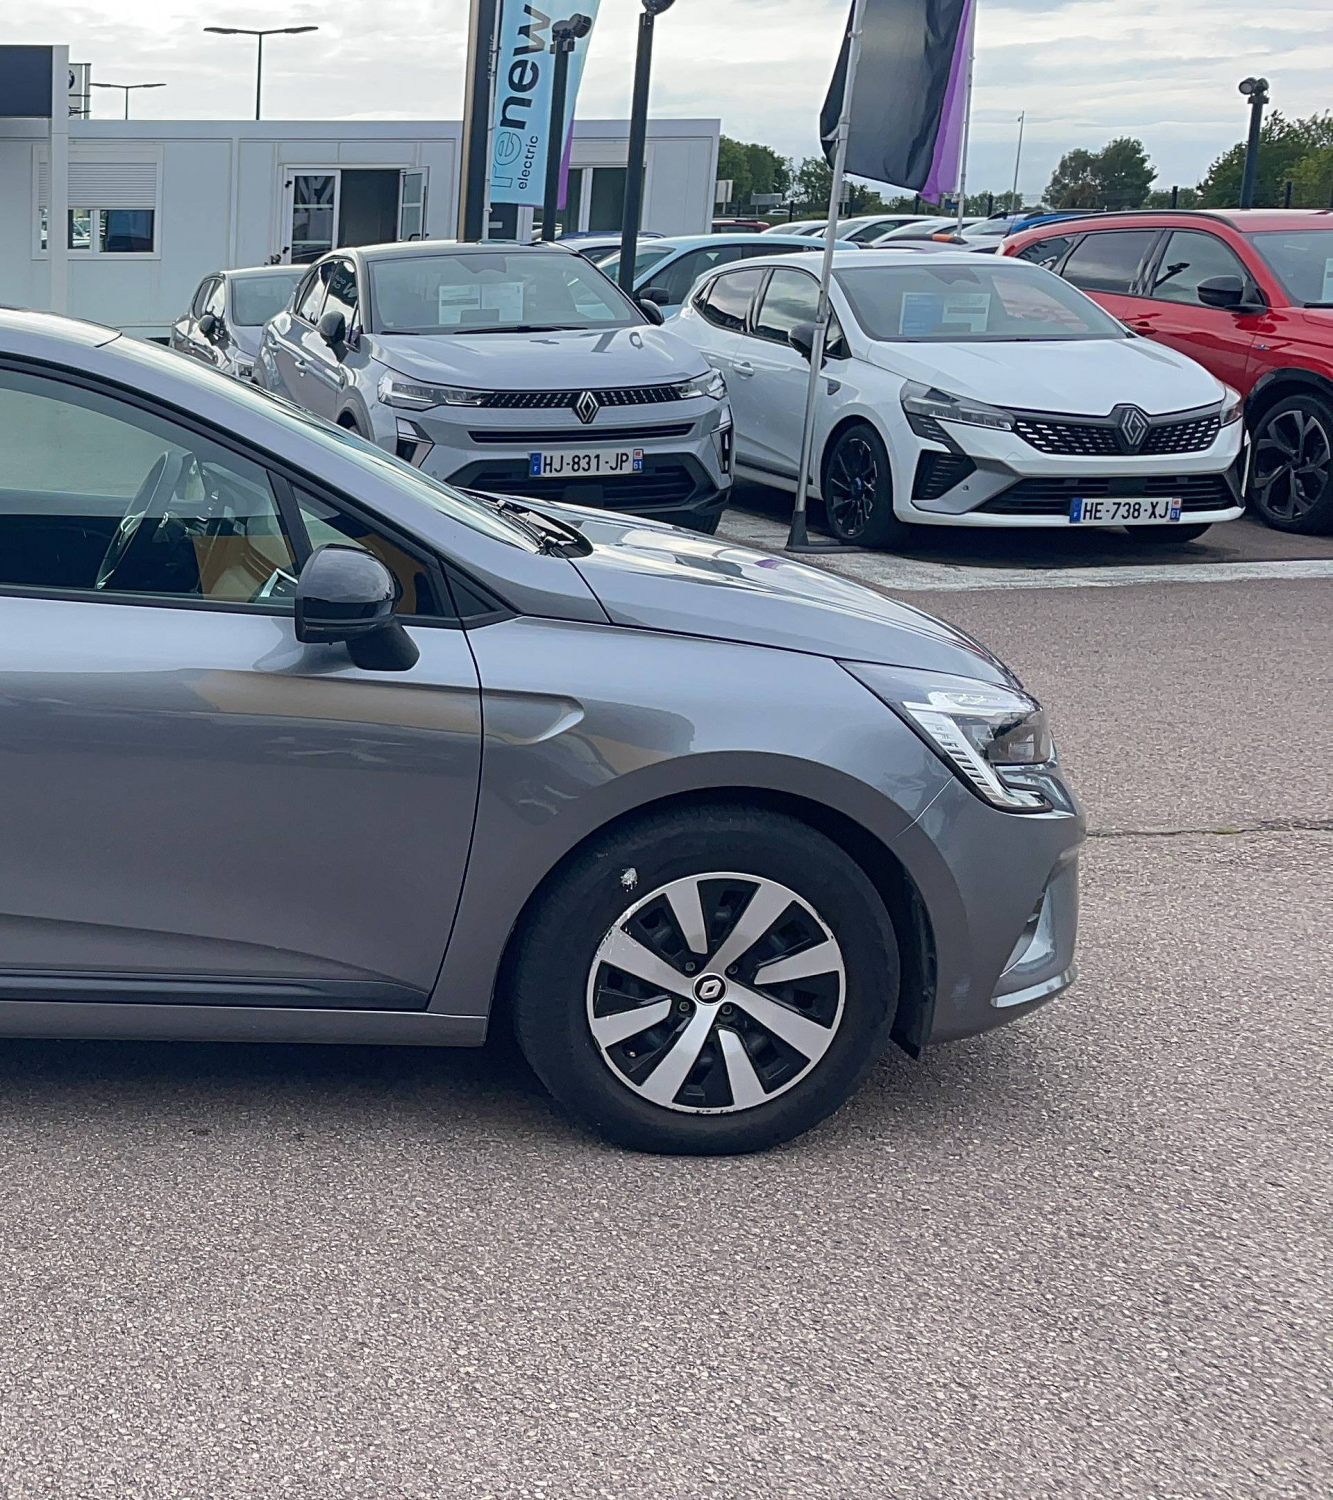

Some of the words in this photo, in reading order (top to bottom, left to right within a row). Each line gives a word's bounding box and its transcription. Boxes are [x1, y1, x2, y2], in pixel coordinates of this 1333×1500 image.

[491, 4, 551, 189] renew
[518, 135, 539, 190] electric
[542, 453, 630, 473] HJ-831-JP
[633, 461, 642, 470] 61
[1082, 501, 1169, 520] HE-738-XJ
